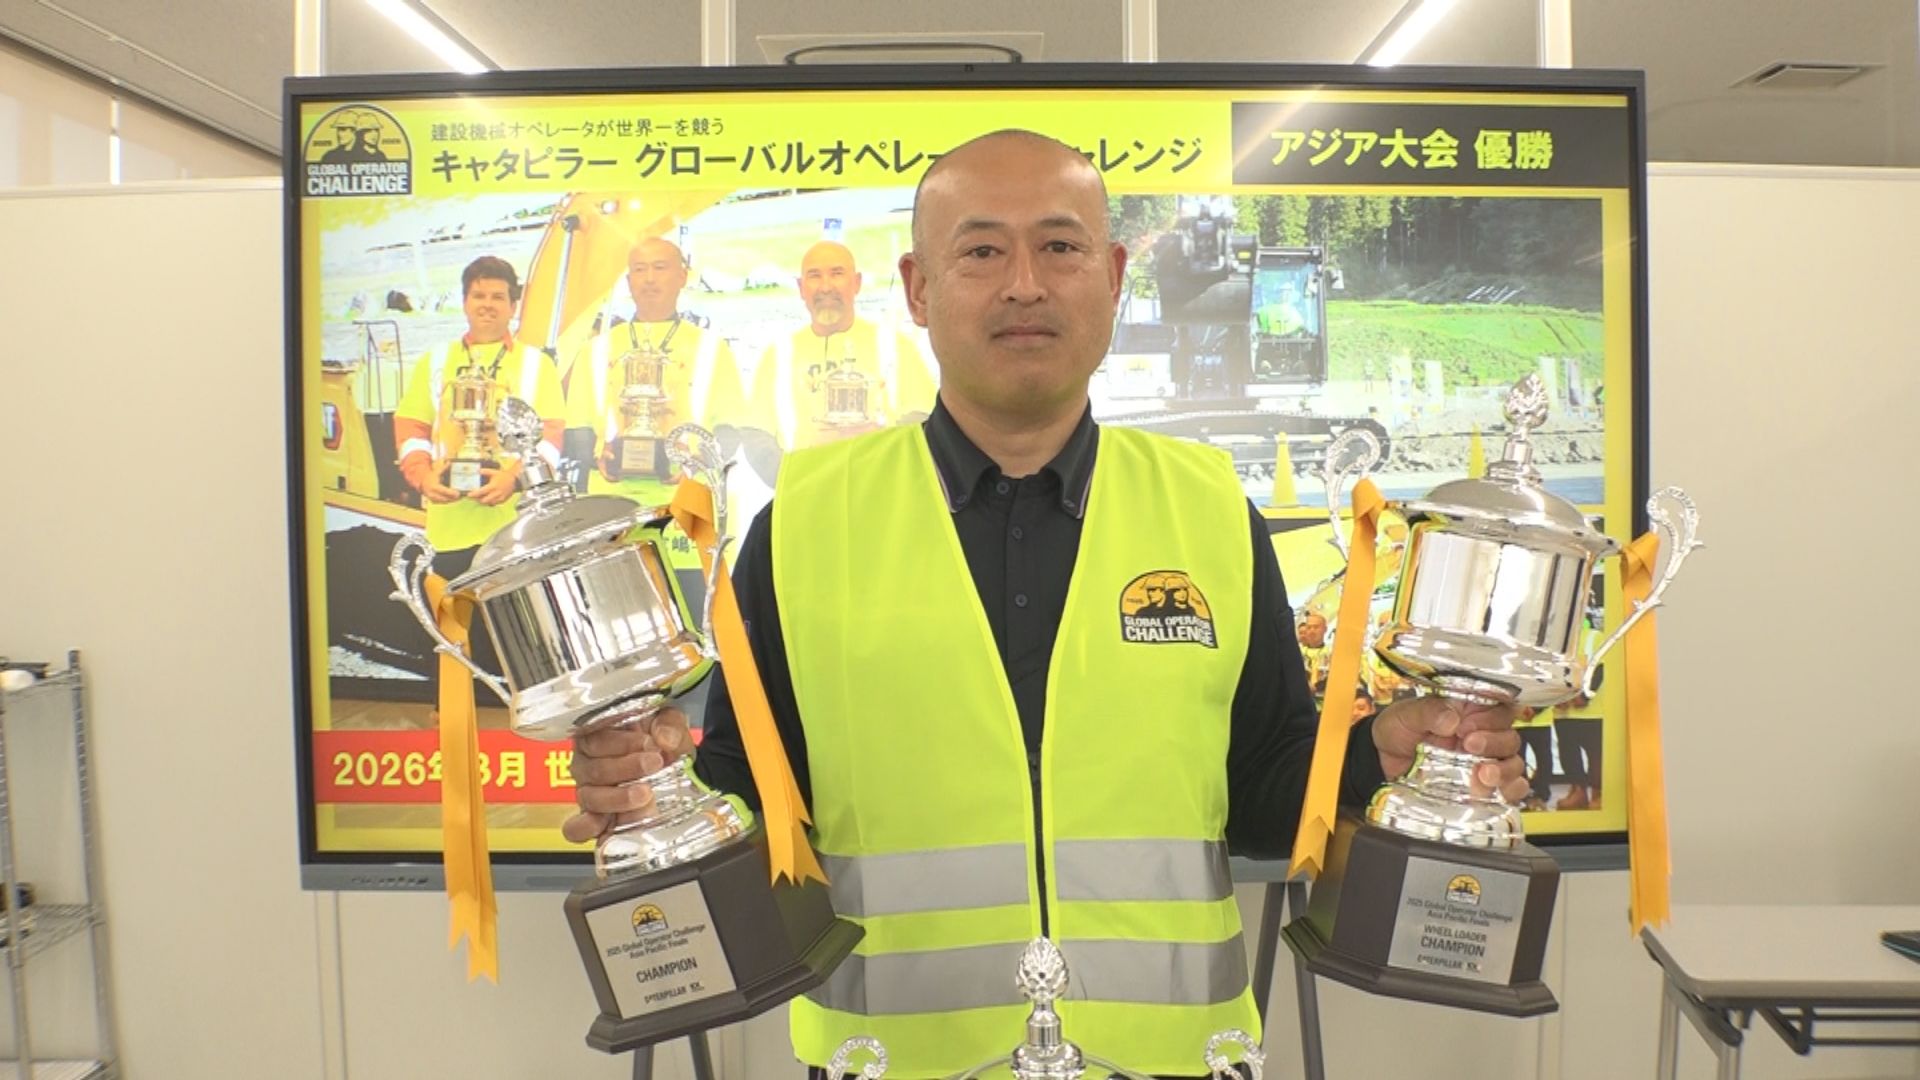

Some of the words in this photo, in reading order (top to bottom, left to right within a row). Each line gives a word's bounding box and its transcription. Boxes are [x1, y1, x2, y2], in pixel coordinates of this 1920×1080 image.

[432, 118, 724, 141] 建設機械オペレータが世界一を競う
[1270, 128, 1459, 169] アジア大会
[1473, 129, 1553, 170] 優勝
[307, 163, 349, 176] GLOBAL
[351, 162, 408, 175] OPERATOR
[431, 146, 617, 183] キャタピラー
[307, 174, 408, 195] CHALLENGE
[1124, 616, 1163, 628] GLOBAL
[1424, 923, 1453, 938] WHEEL
[1454, 930, 1487, 943] LOADER
[1420, 935, 1487, 958] CHAMPION
[636, 956, 698, 983] CHAMPION
